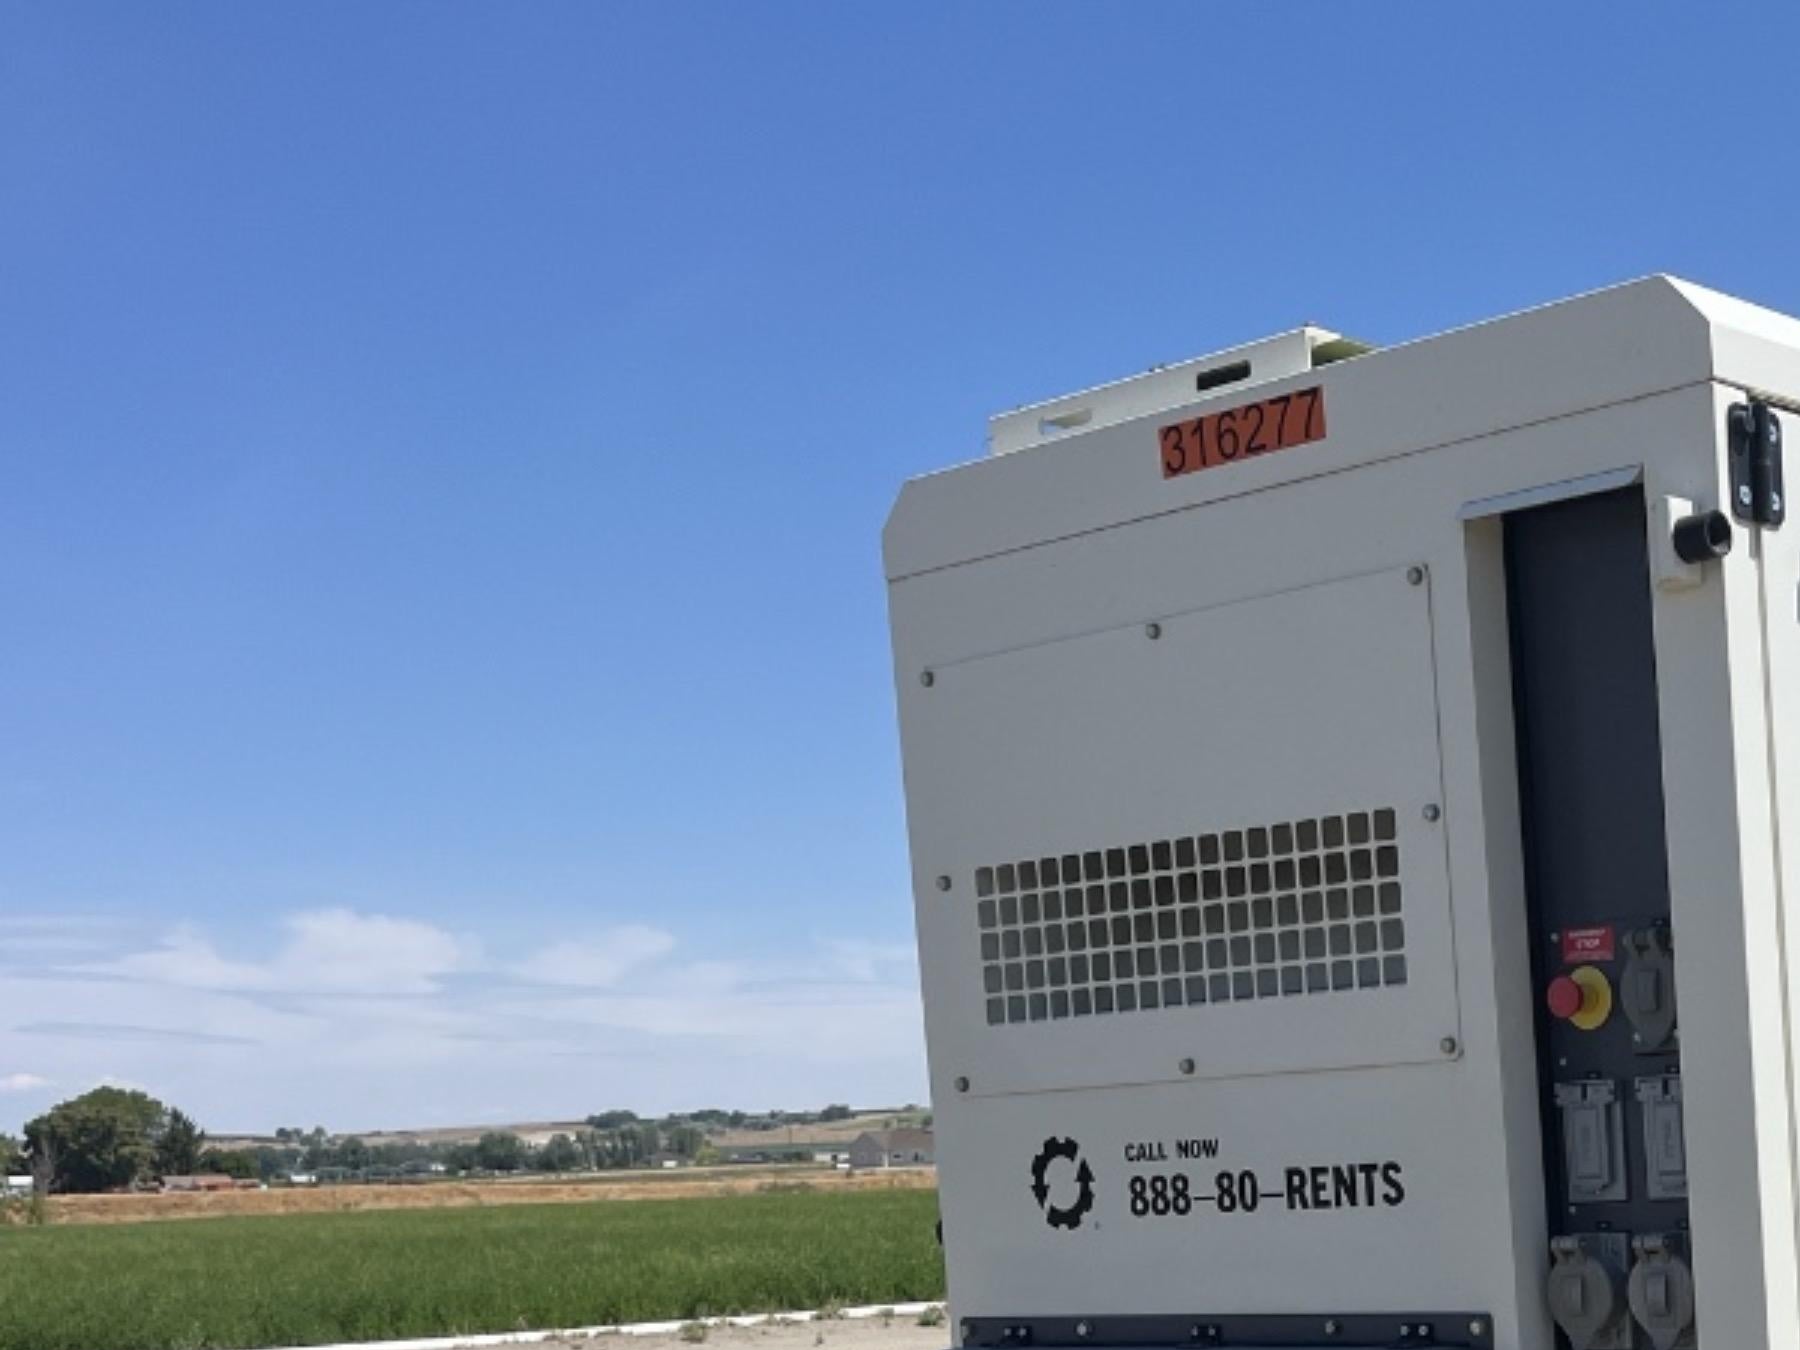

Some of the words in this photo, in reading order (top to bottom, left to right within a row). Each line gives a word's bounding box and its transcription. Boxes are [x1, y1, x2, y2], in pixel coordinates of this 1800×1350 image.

[1163, 386, 1320, 473] 316277
[1124, 1142, 1168, 1162] CALL
[1176, 1139, 1219, 1159] NOW
